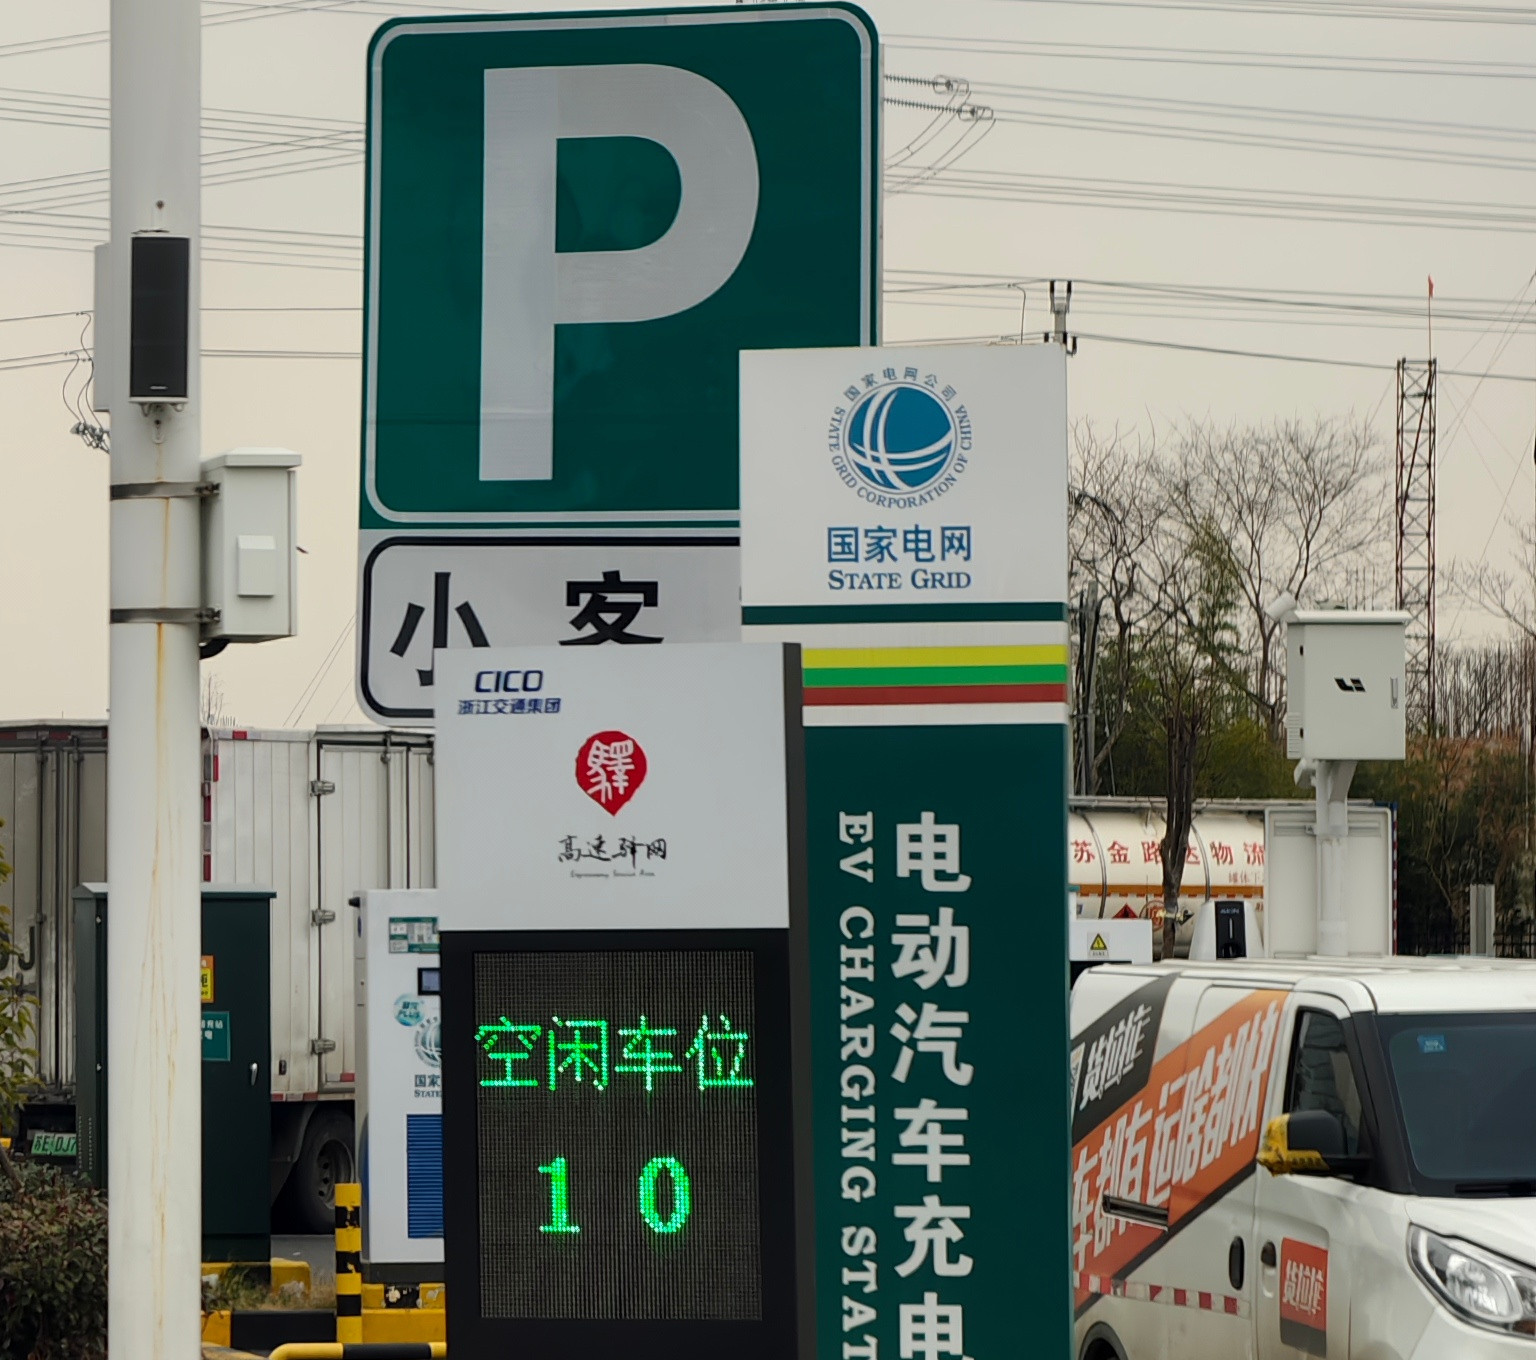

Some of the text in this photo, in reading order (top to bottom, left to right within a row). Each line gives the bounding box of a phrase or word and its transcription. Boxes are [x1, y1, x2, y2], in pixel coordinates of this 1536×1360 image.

[479, 63, 761, 482] P
[843, 367, 958, 402] 国家电网公司
[828, 405, 973, 510] STATE GRID CORPORATION OF CHINA
[827, 524, 973, 564] 国家电网
[828, 568, 972, 591] STATE GRID
[457, 697, 562, 716] 浙江交通集团
[475, 669, 544, 693] CICO
[839, 810, 875, 884] EV
[476, 1015, 754, 1091] 空闲车位
[839, 905, 876, 1202] CHARGING
[1079, 1003, 1152, 1110] 货拉拉
[1283, 1259, 1324, 1316] 货拉拉
